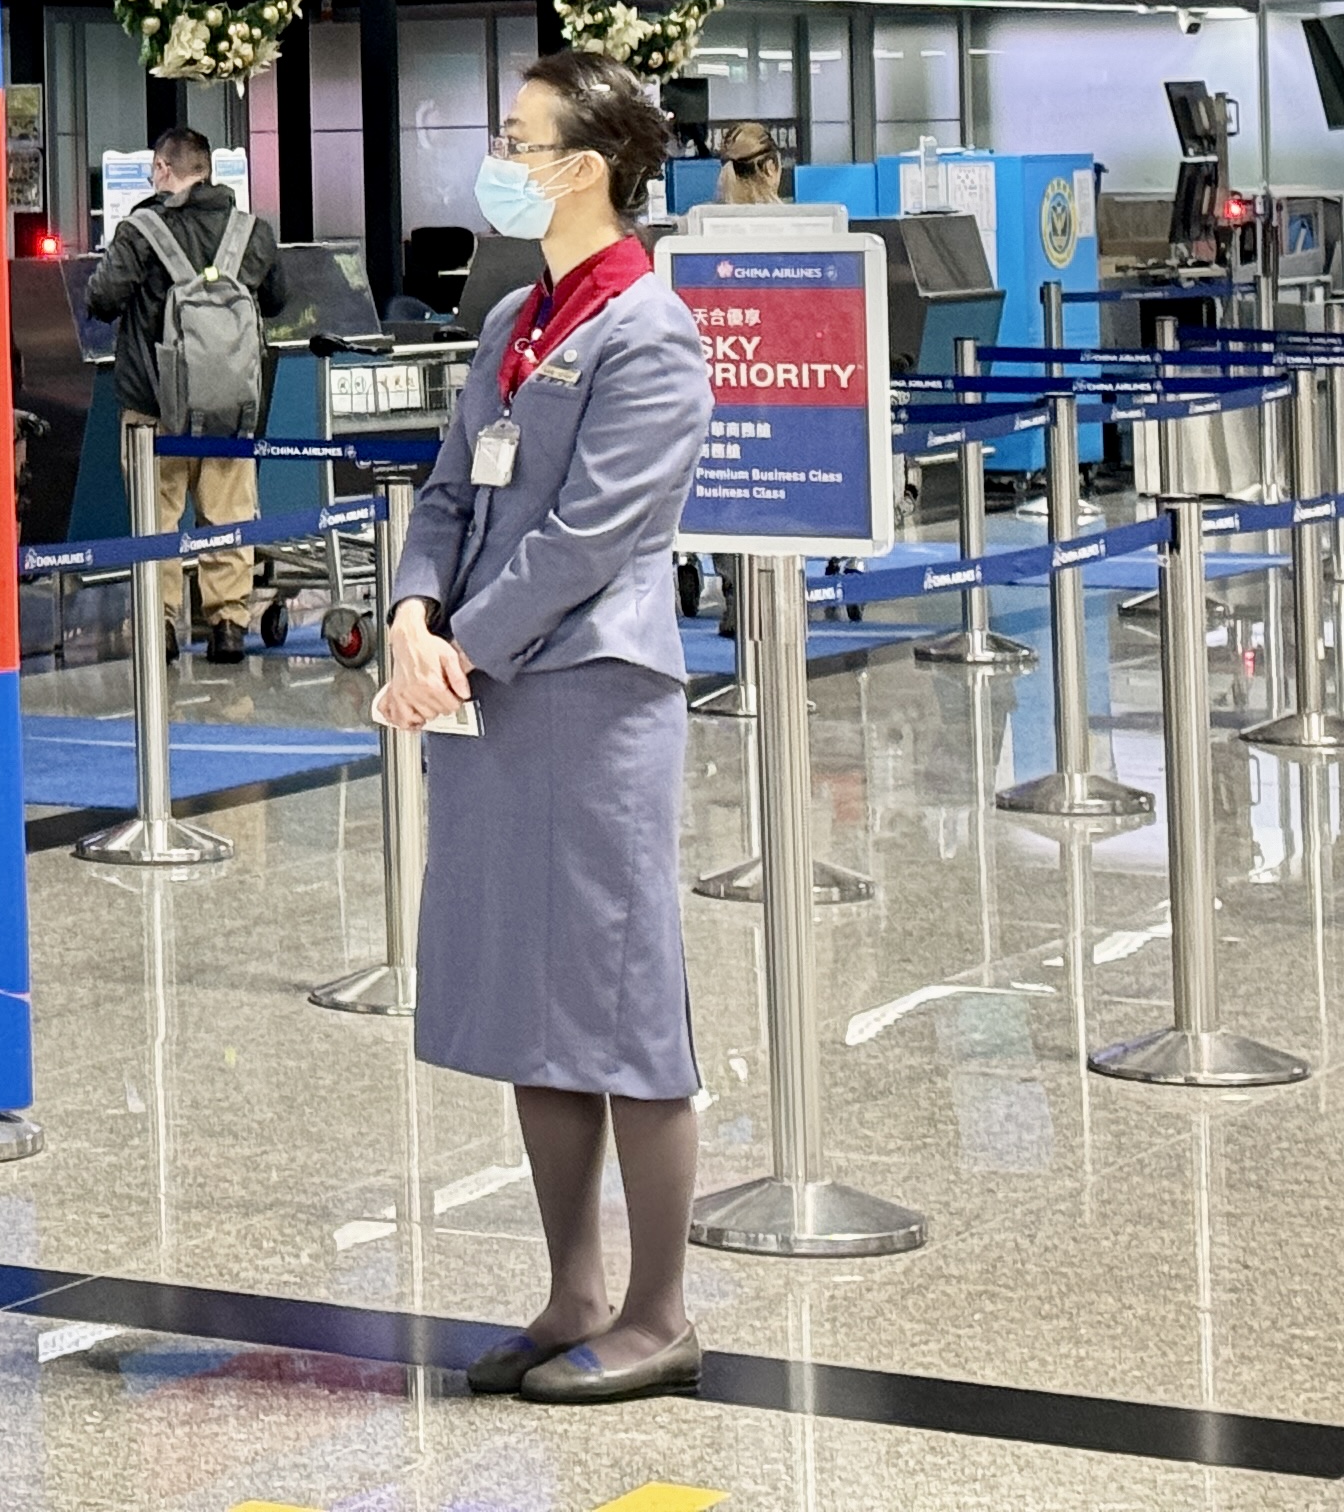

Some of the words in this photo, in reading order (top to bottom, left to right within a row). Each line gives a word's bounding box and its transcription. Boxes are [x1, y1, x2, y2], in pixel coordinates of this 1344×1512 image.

[734, 268, 770, 279] CHINA
[771, 268, 822, 279] AIRLINES
[700, 336, 761, 360] SKY
[270, 447, 301, 456] CHINA
[302, 446, 343, 457] AIRLINES
[696, 467, 749, 482] Premium
[751, 468, 806, 483] Business
[808, 469, 842, 483] Class
[696, 485, 750, 499] Business
[752, 486, 786, 499] Class
